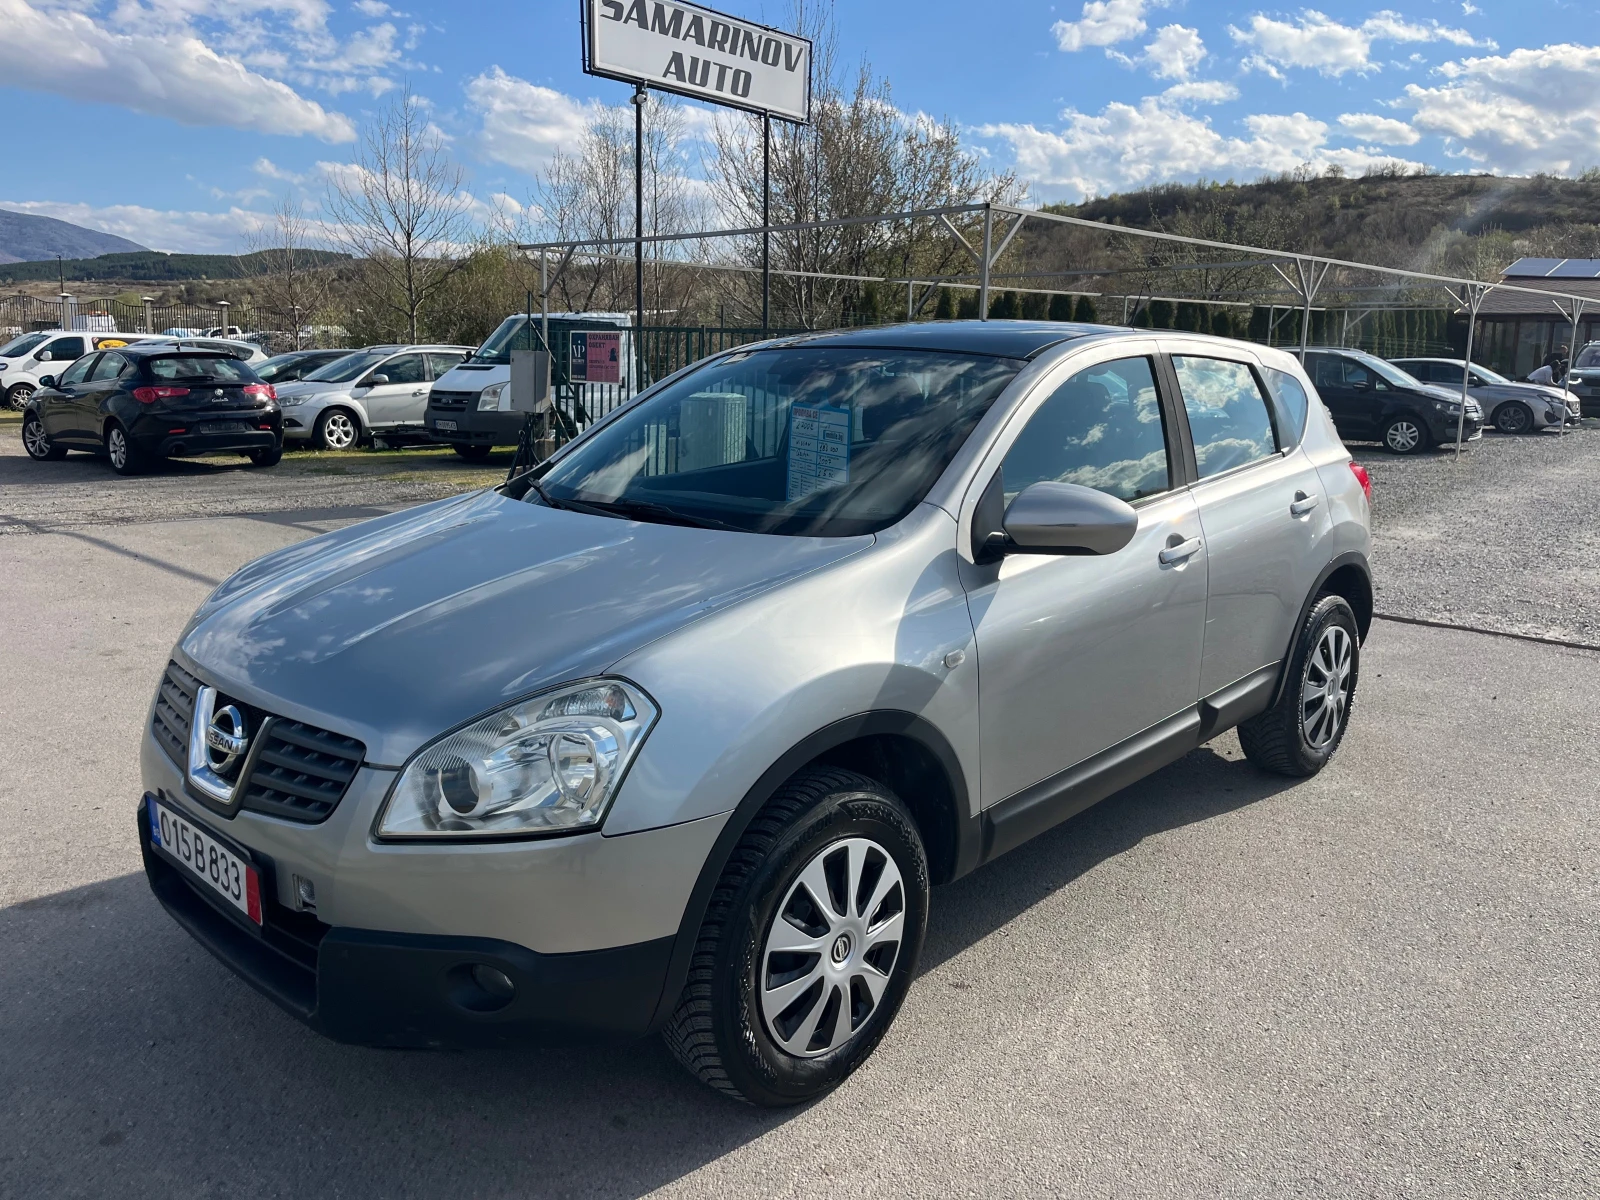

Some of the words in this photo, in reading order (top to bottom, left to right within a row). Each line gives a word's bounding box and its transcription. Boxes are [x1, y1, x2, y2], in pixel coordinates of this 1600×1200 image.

[600, 0, 803, 72] SAMARINOV
[662, 51, 752, 98] AUTO
[573, 341, 585, 357] VIP
[825, 431, 843, 442] mobile.bg
